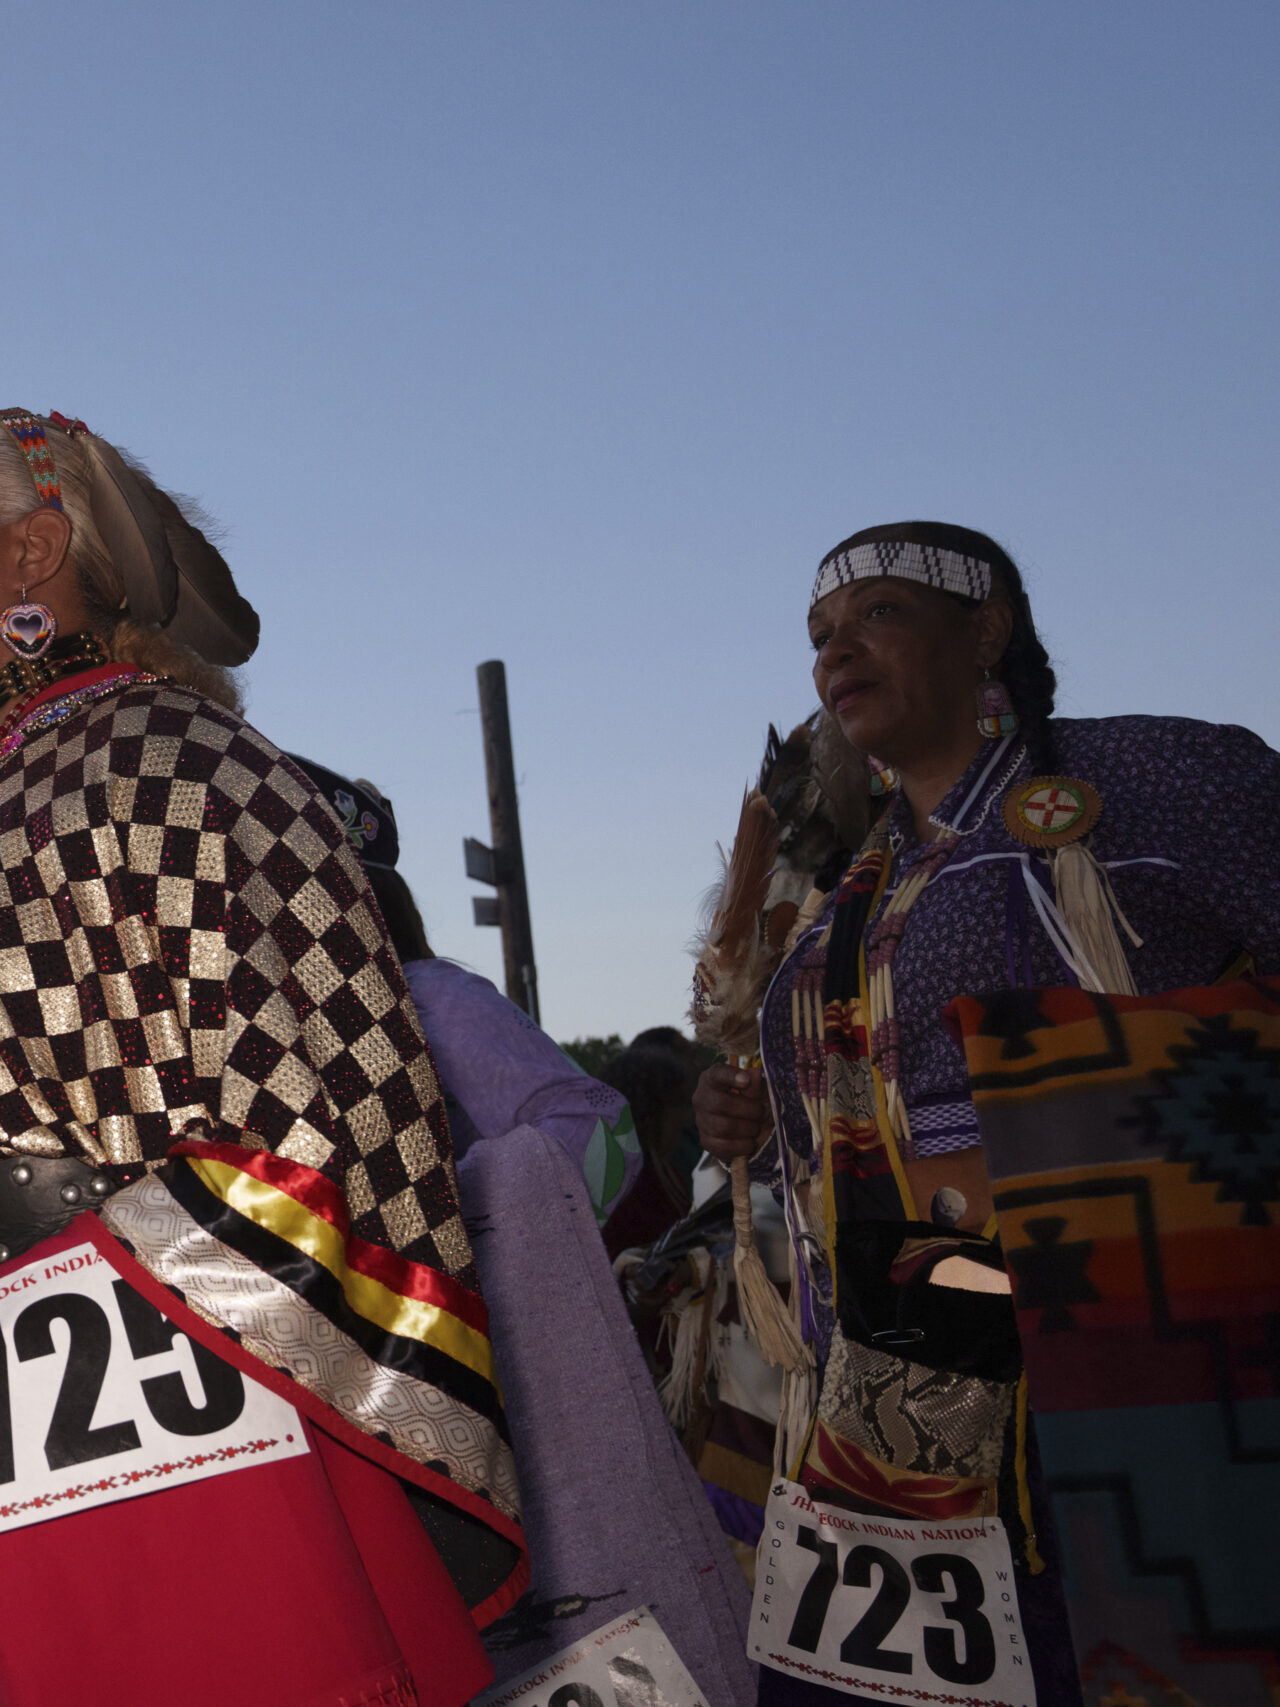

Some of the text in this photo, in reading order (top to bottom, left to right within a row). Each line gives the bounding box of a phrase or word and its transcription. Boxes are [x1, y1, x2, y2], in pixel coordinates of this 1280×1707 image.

[791, 1495, 988, 1542] SHIECOCK INDIAN NATION
[760, 1520, 786, 1624] GOLDEN
[787, 1524, 997, 1685] 723
[995, 1570, 1023, 1666] WOMEN
